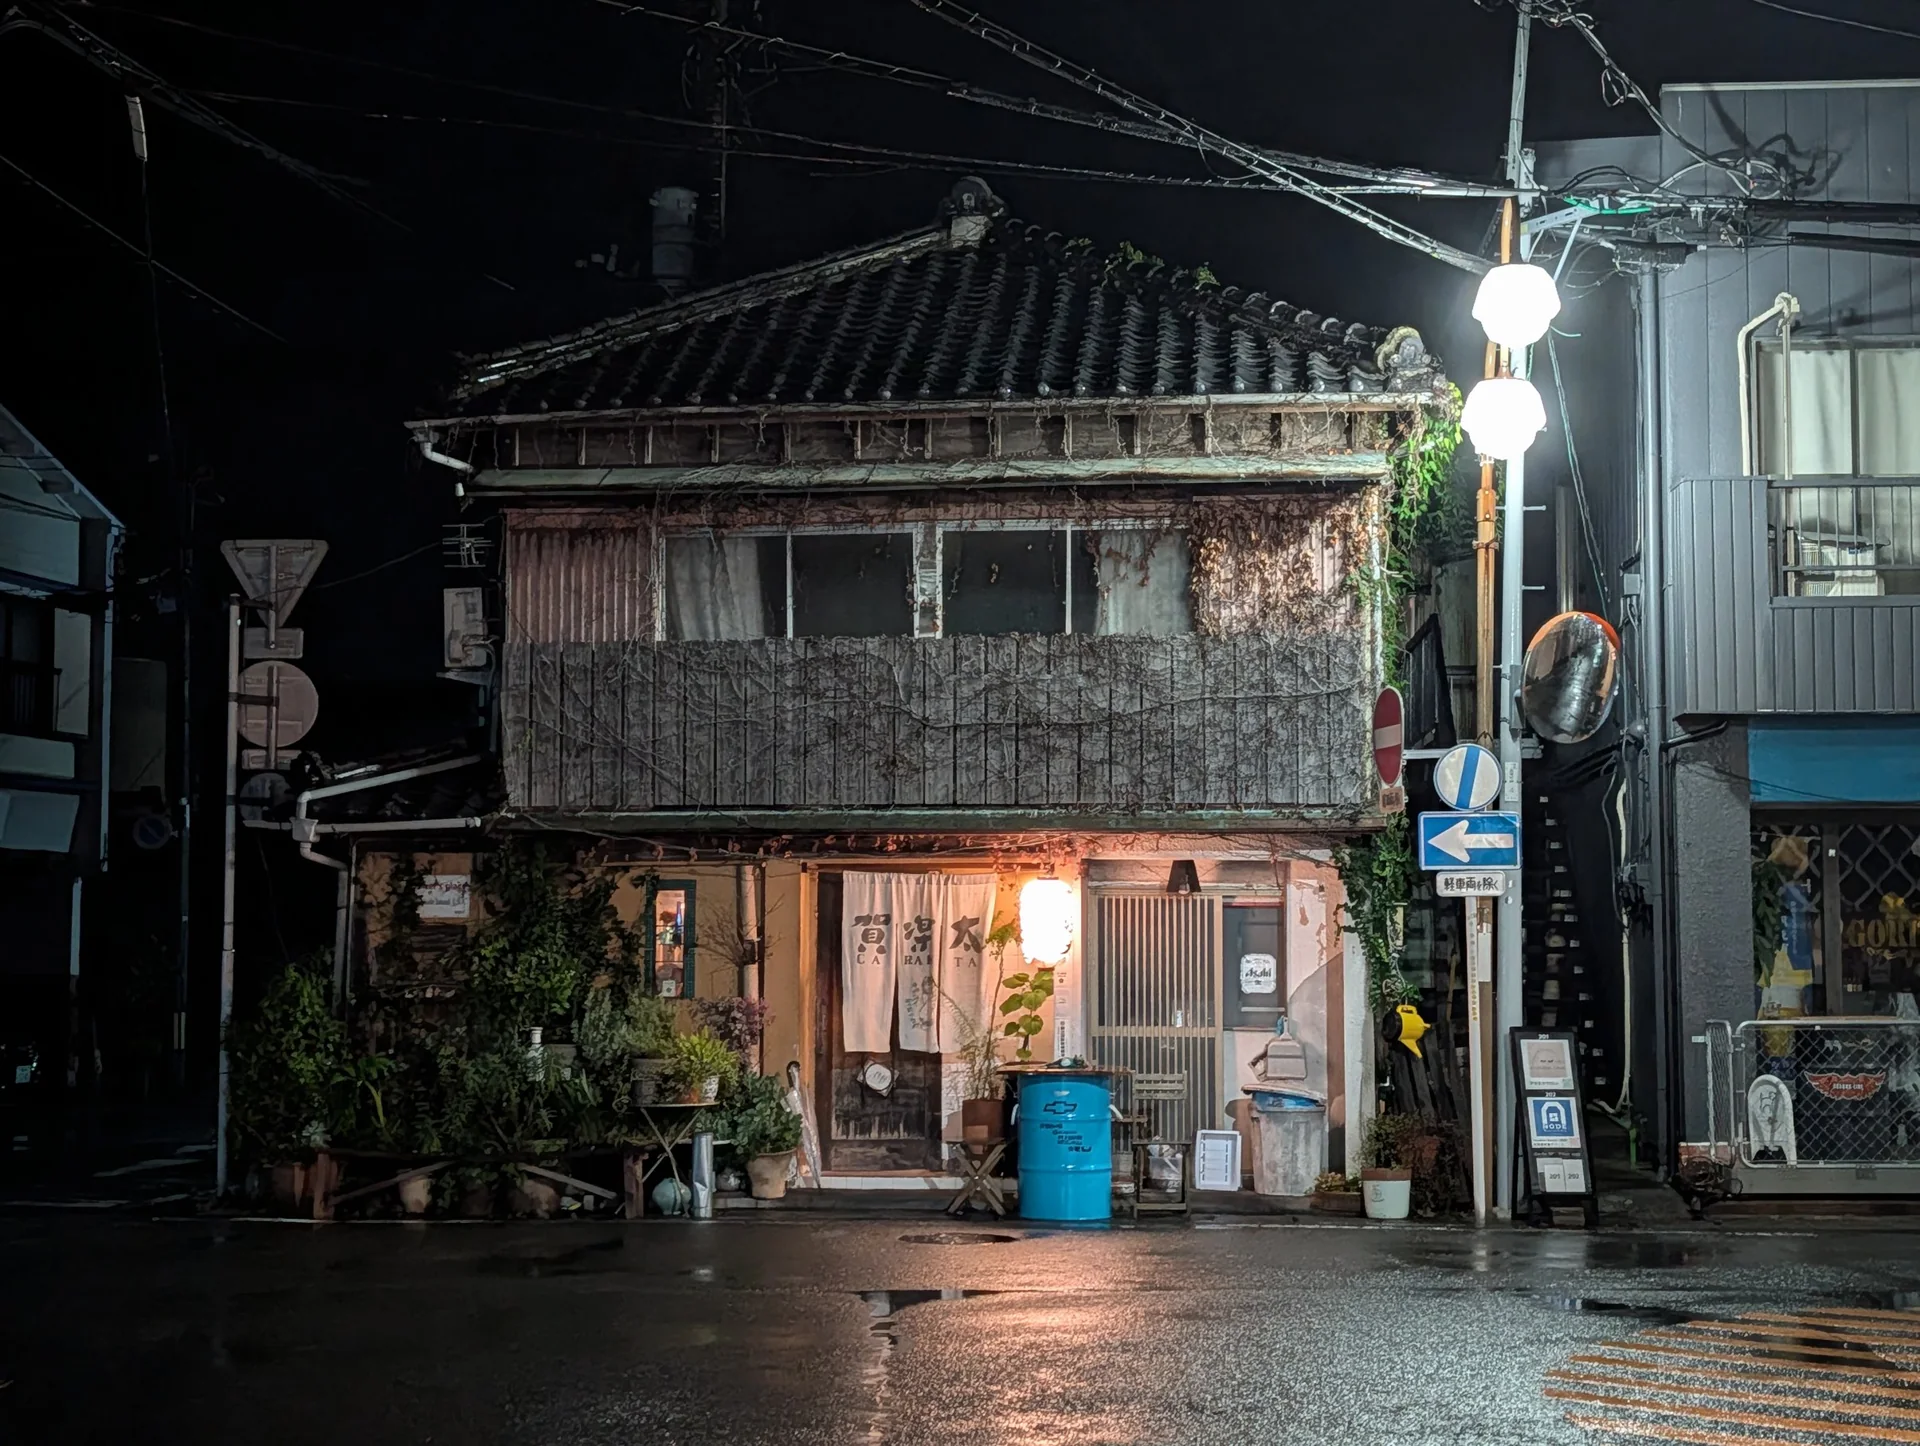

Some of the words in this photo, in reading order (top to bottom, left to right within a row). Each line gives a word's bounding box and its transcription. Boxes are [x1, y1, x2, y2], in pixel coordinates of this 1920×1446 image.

[1444, 876, 1499, 891] 軽車両を除く
[1245, 967, 1272, 978] Asahi
